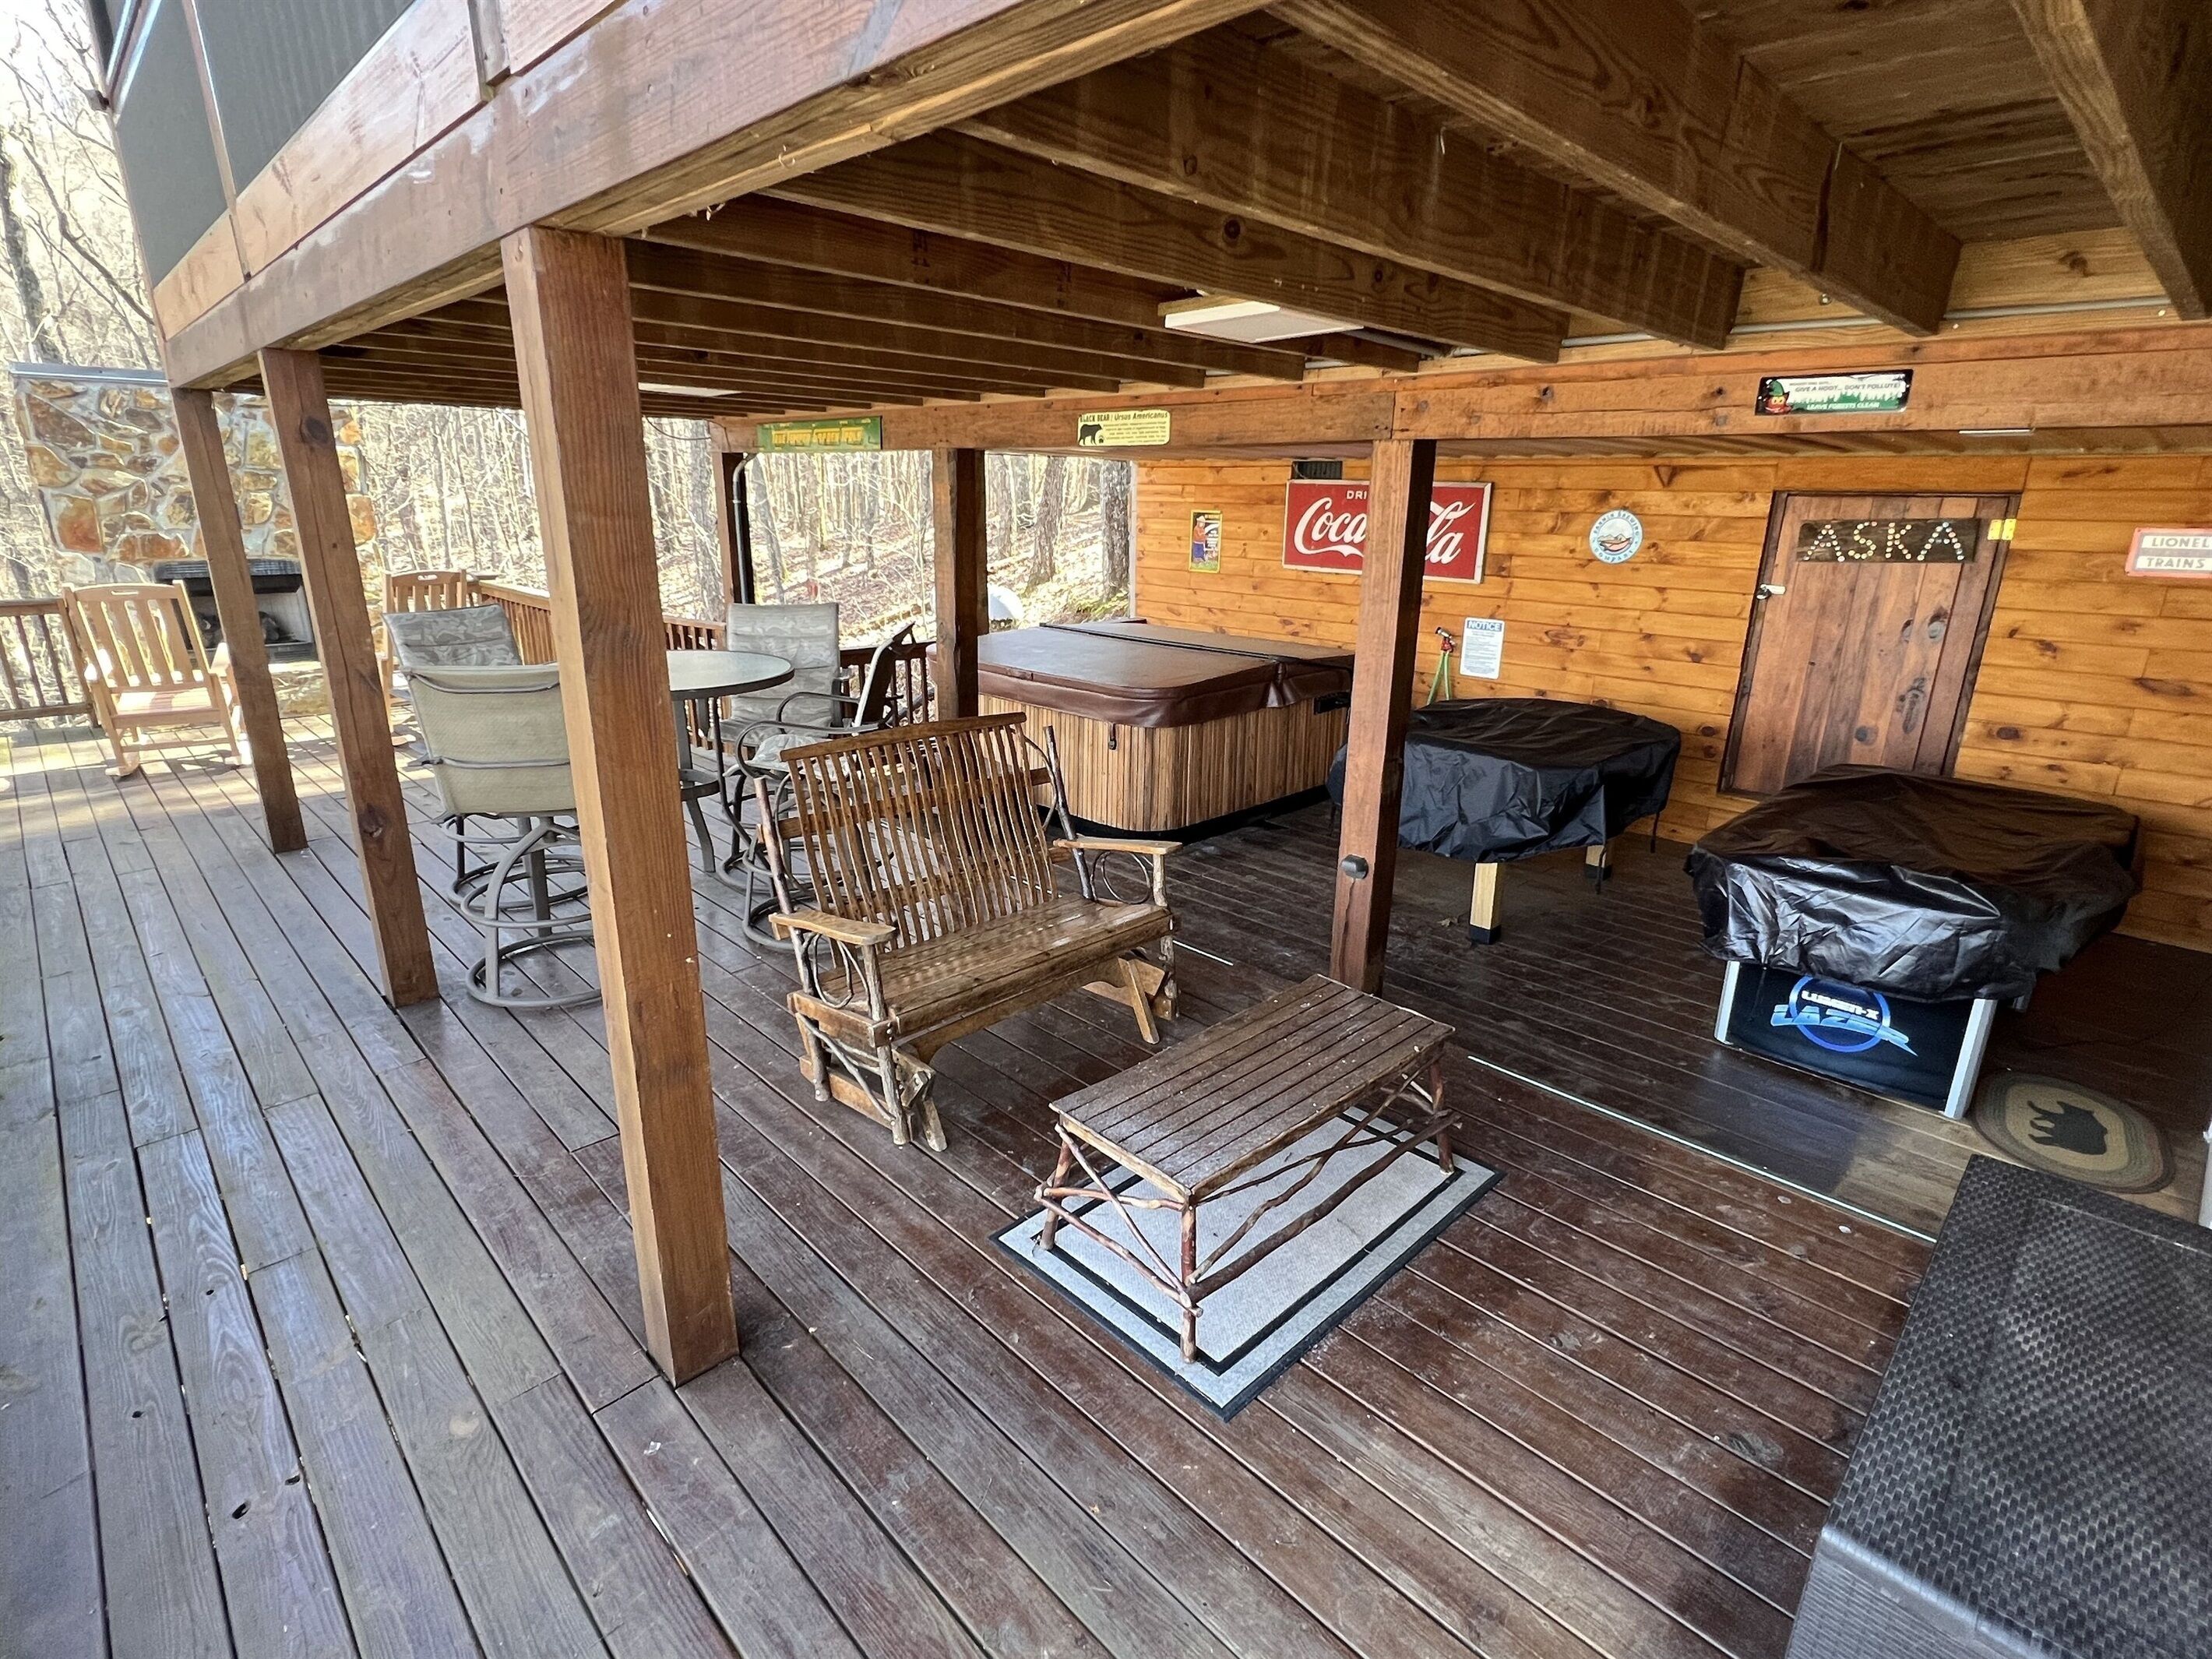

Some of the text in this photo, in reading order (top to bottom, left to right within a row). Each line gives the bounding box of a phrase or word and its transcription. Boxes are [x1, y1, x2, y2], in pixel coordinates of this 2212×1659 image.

[1080, 414, 1095, 423] BLACK
[1132, 411, 1168, 420] Americanus
[1346, 490, 1367, 501] DRI
[1803, 521, 1964, 562] ASKA
[2152, 537, 2210, 548] LIONEL
[2147, 558, 2206, 569] TRAINS
[1468, 621, 1501, 631] NOTICE
